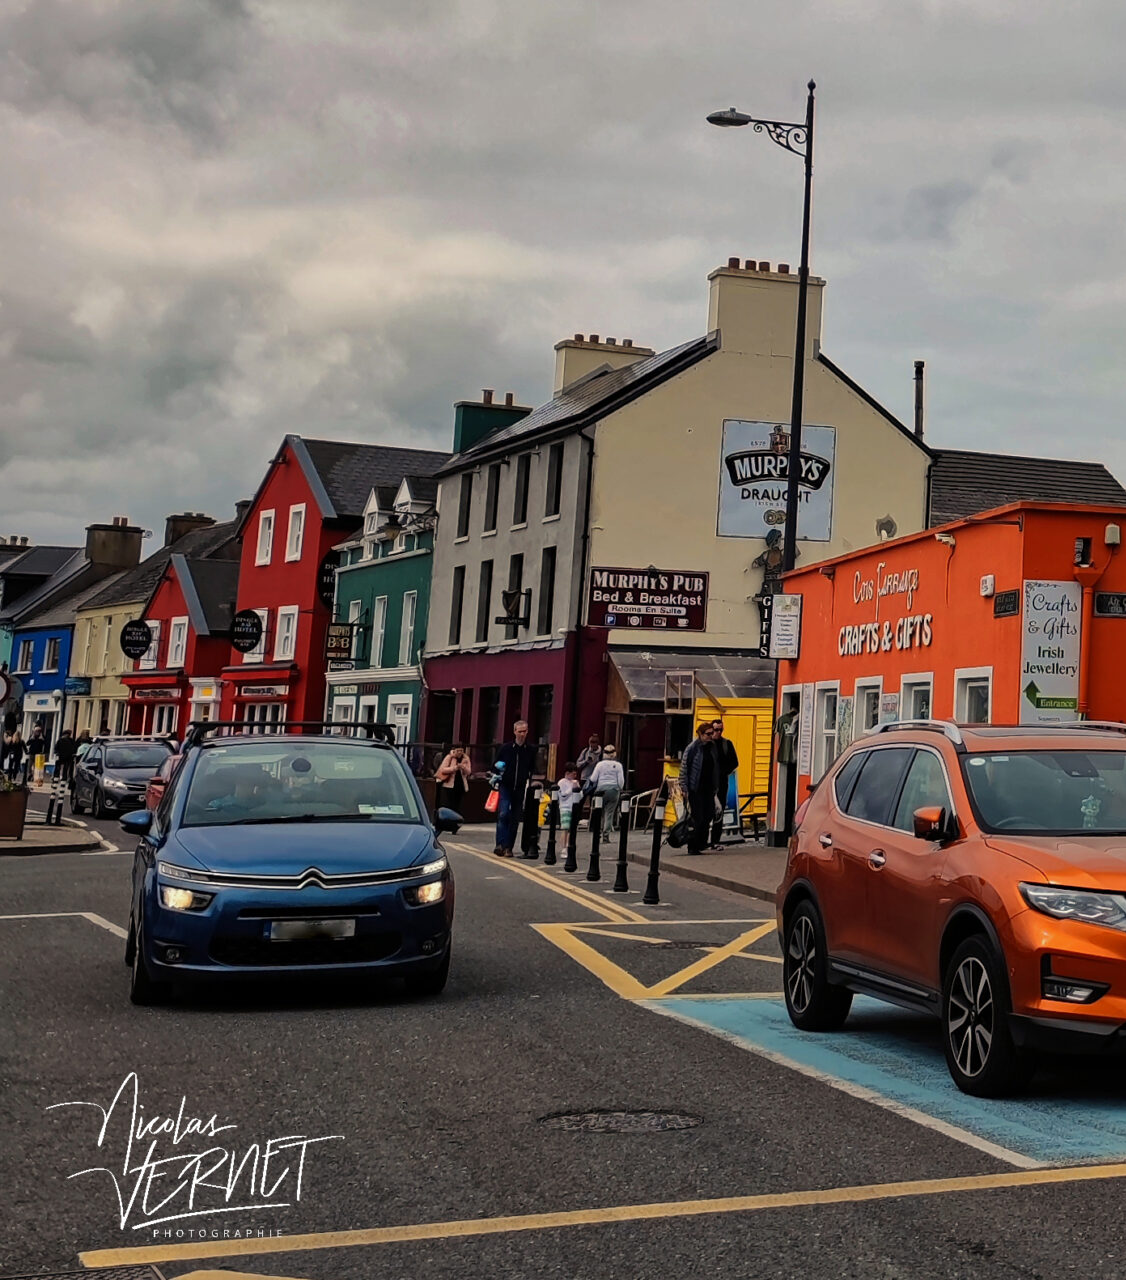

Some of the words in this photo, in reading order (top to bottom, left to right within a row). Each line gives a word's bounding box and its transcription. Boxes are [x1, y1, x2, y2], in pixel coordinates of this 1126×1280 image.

[593, 570, 669, 591] MURPHY'S
[672, 574, 704, 592] PUB
[593, 590, 620, 602] Bed
[624, 591, 634, 603] &
[640, 592, 702, 606] Breakfast
[1032, 593, 1078, 616] Crafts
[760, 596, 772, 657] GIFTS
[838, 622, 880, 656] CRAFTS
[881, 620, 893, 652] &
[895, 613, 934, 650] GIFTS
[1028, 620, 1040, 634] &
[1043, 617, 1078, 641] Gifts
[1037, 646, 1065, 659] Irish
[1023, 662, 1078, 678] Jewellery
[1040, 698, 1074, 708] Entrance
